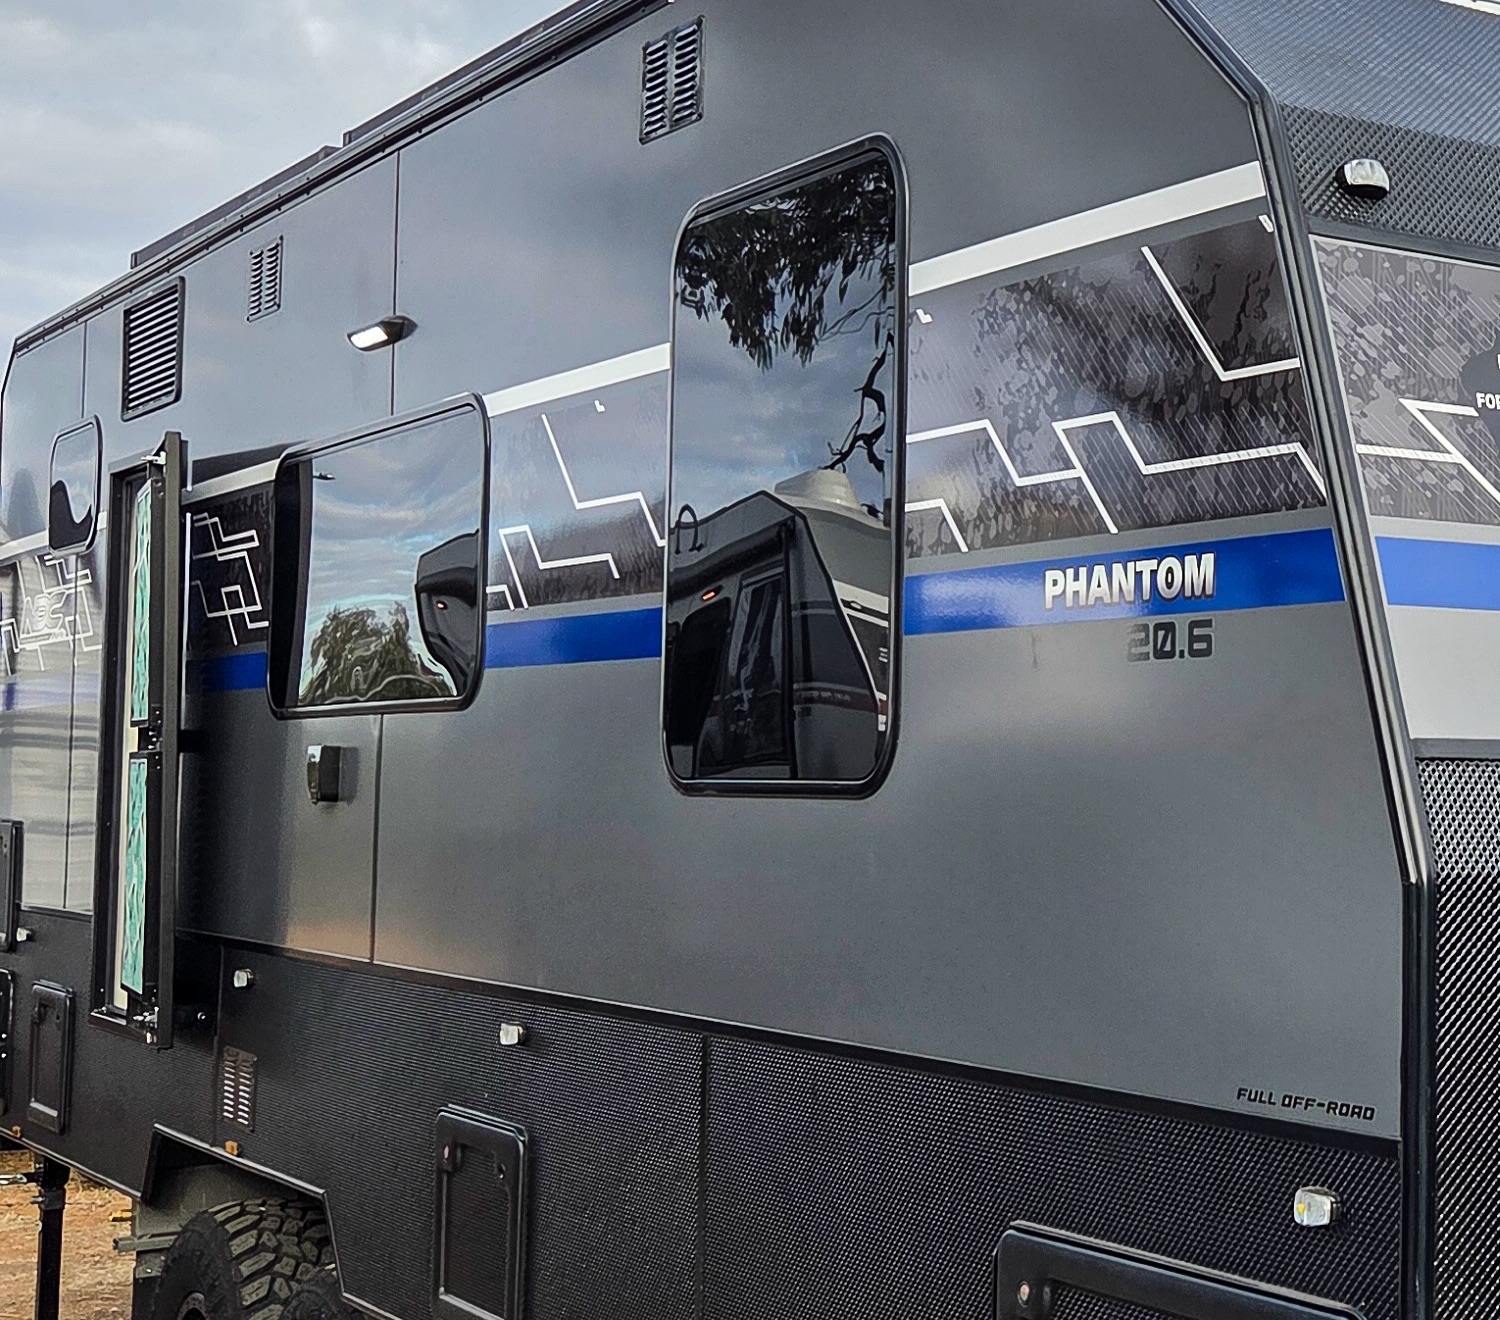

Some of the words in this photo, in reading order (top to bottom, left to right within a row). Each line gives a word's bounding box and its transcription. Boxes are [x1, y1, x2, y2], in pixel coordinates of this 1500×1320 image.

[1044, 551, 1215, 610] PHANTOM
[1126, 618, 1214, 663] 20.6
[1236, 1087, 1277, 1106] FULL
[1281, 1093, 1375, 1121] OFF-ROAD
